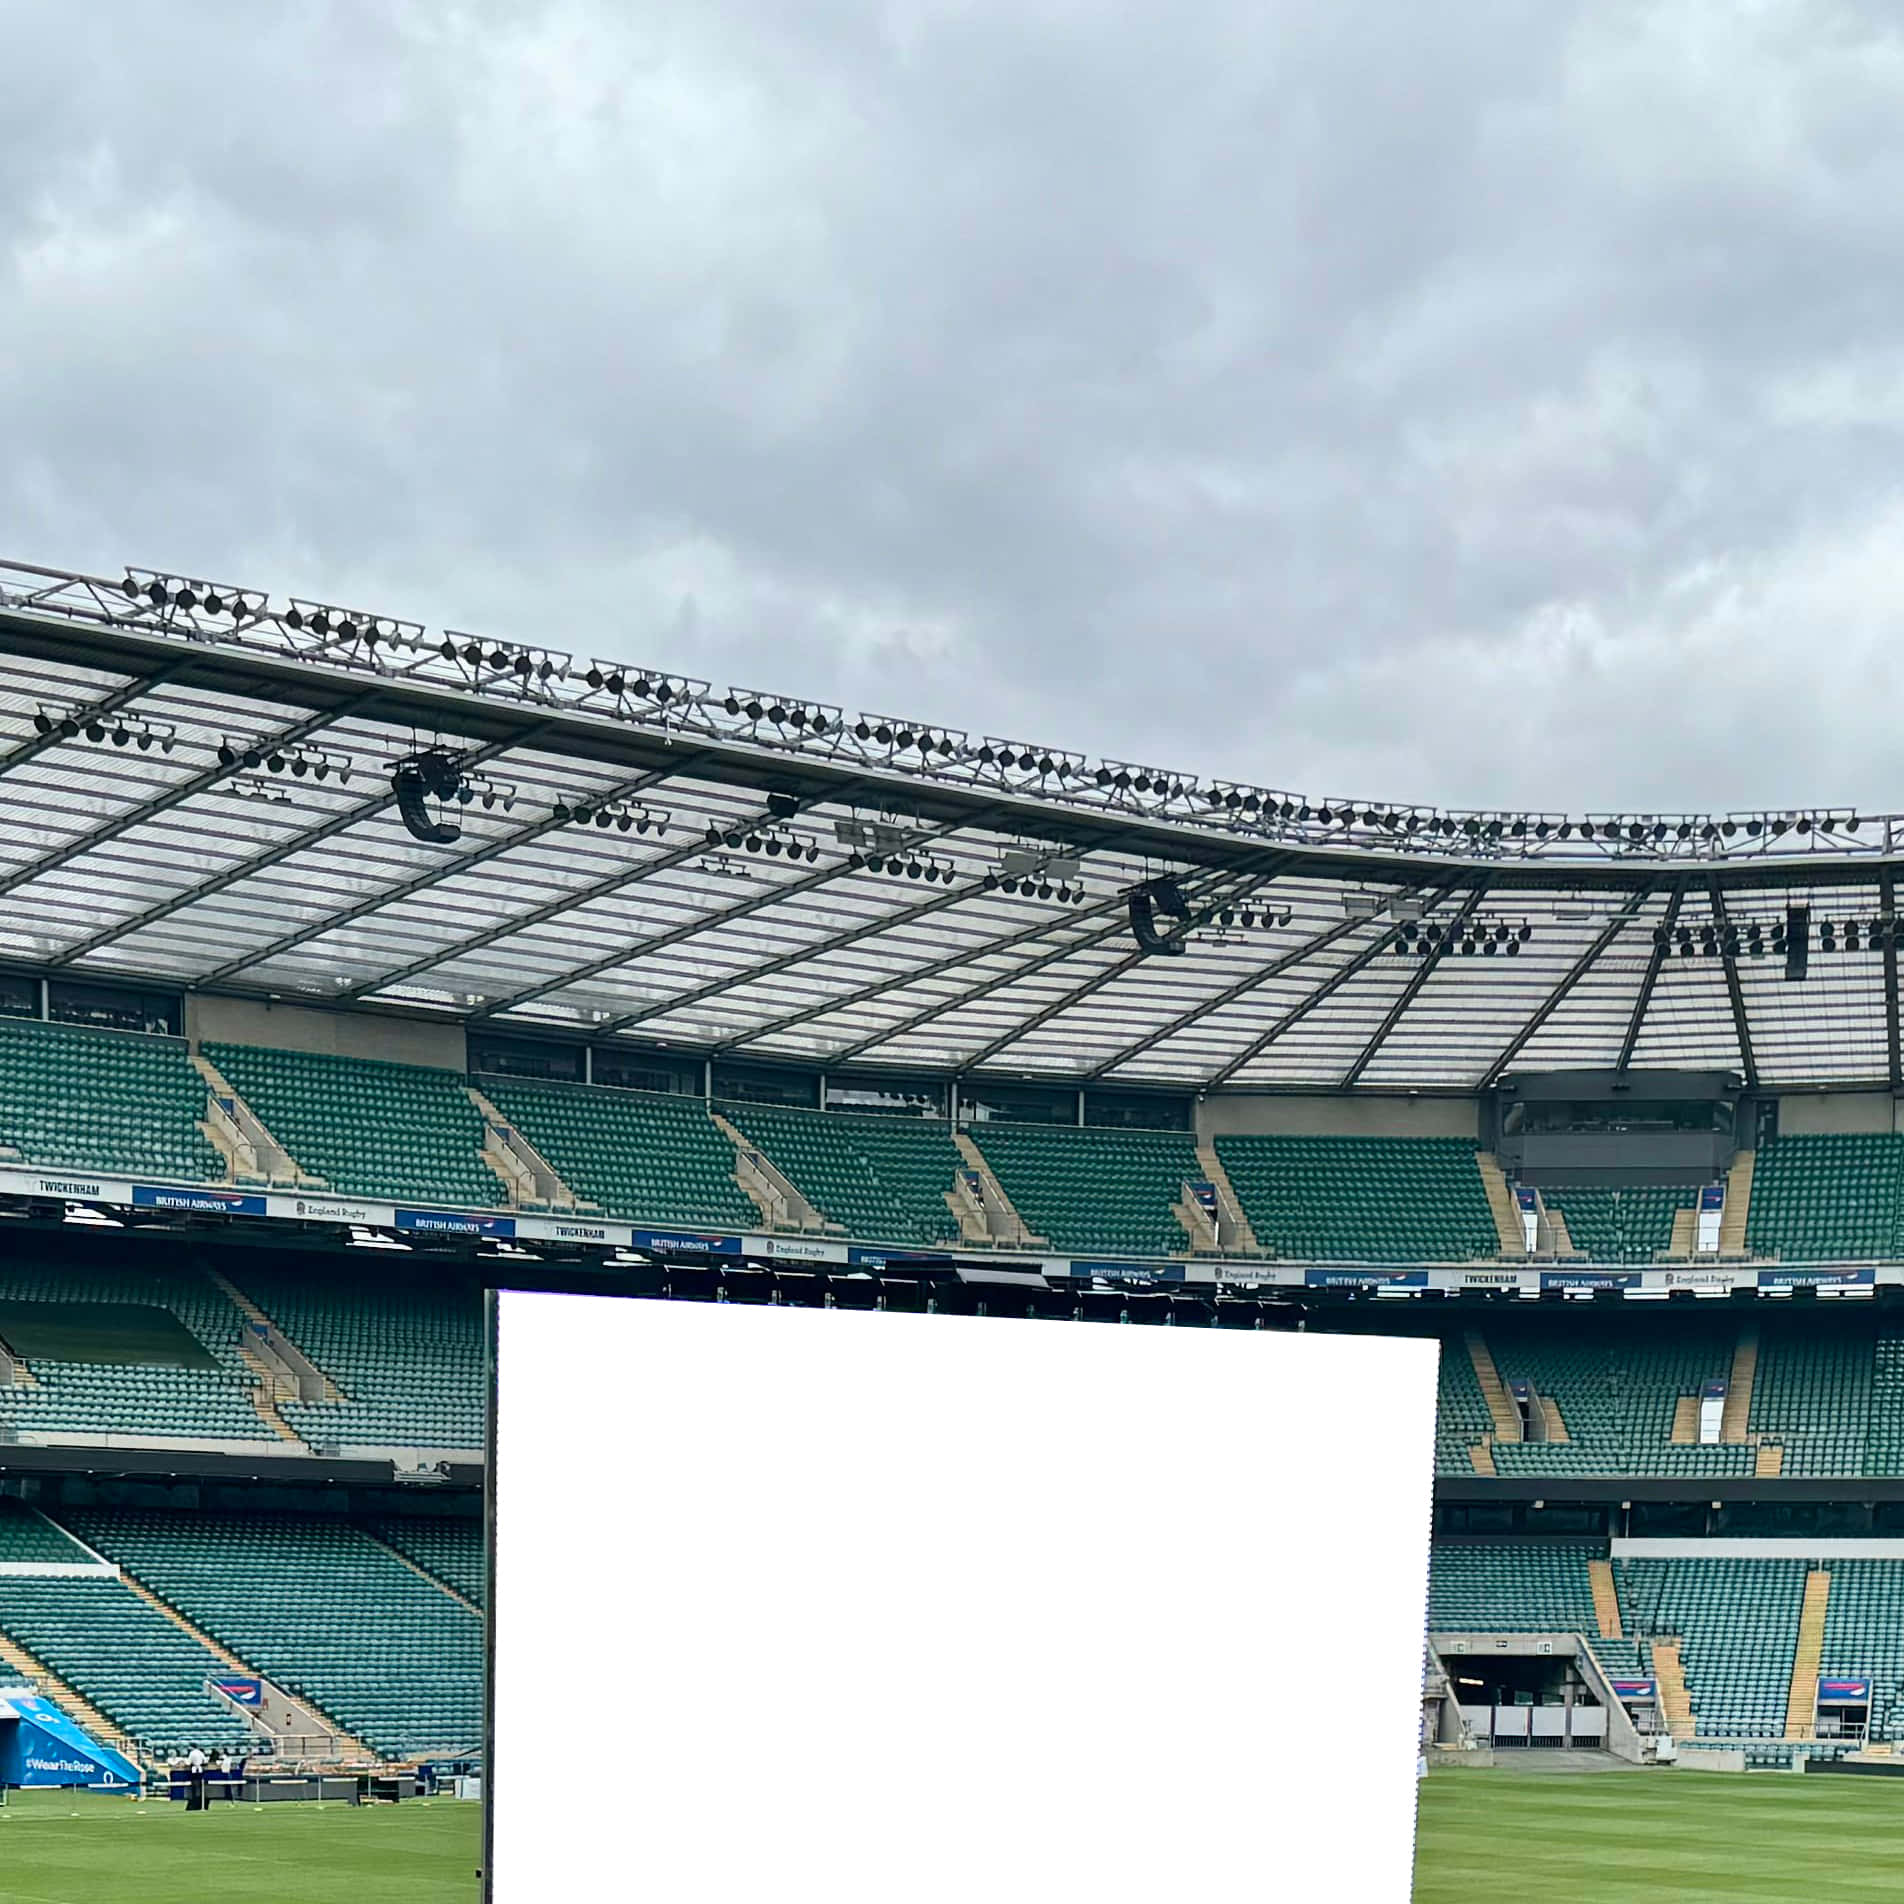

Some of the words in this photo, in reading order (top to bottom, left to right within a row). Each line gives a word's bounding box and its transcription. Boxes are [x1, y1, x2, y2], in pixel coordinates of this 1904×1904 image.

[39, 1180, 100, 1196] TWICKENHAM
[155, 1195, 190, 1208] BRITISH
[191, 1198, 227, 1211] AIRWAYS
[307, 1205, 340, 1217] England
[342, 1208, 366, 1219] Rugby
[415, 1218, 446, 1229] BRITISH
[447, 1221, 480, 1233] AIRWAYS
[651, 1238, 679, 1249] BRITISH
[680, 1240, 710, 1251] AIRWAYS
[25, 1758, 95, 1773] #WearTheRose
